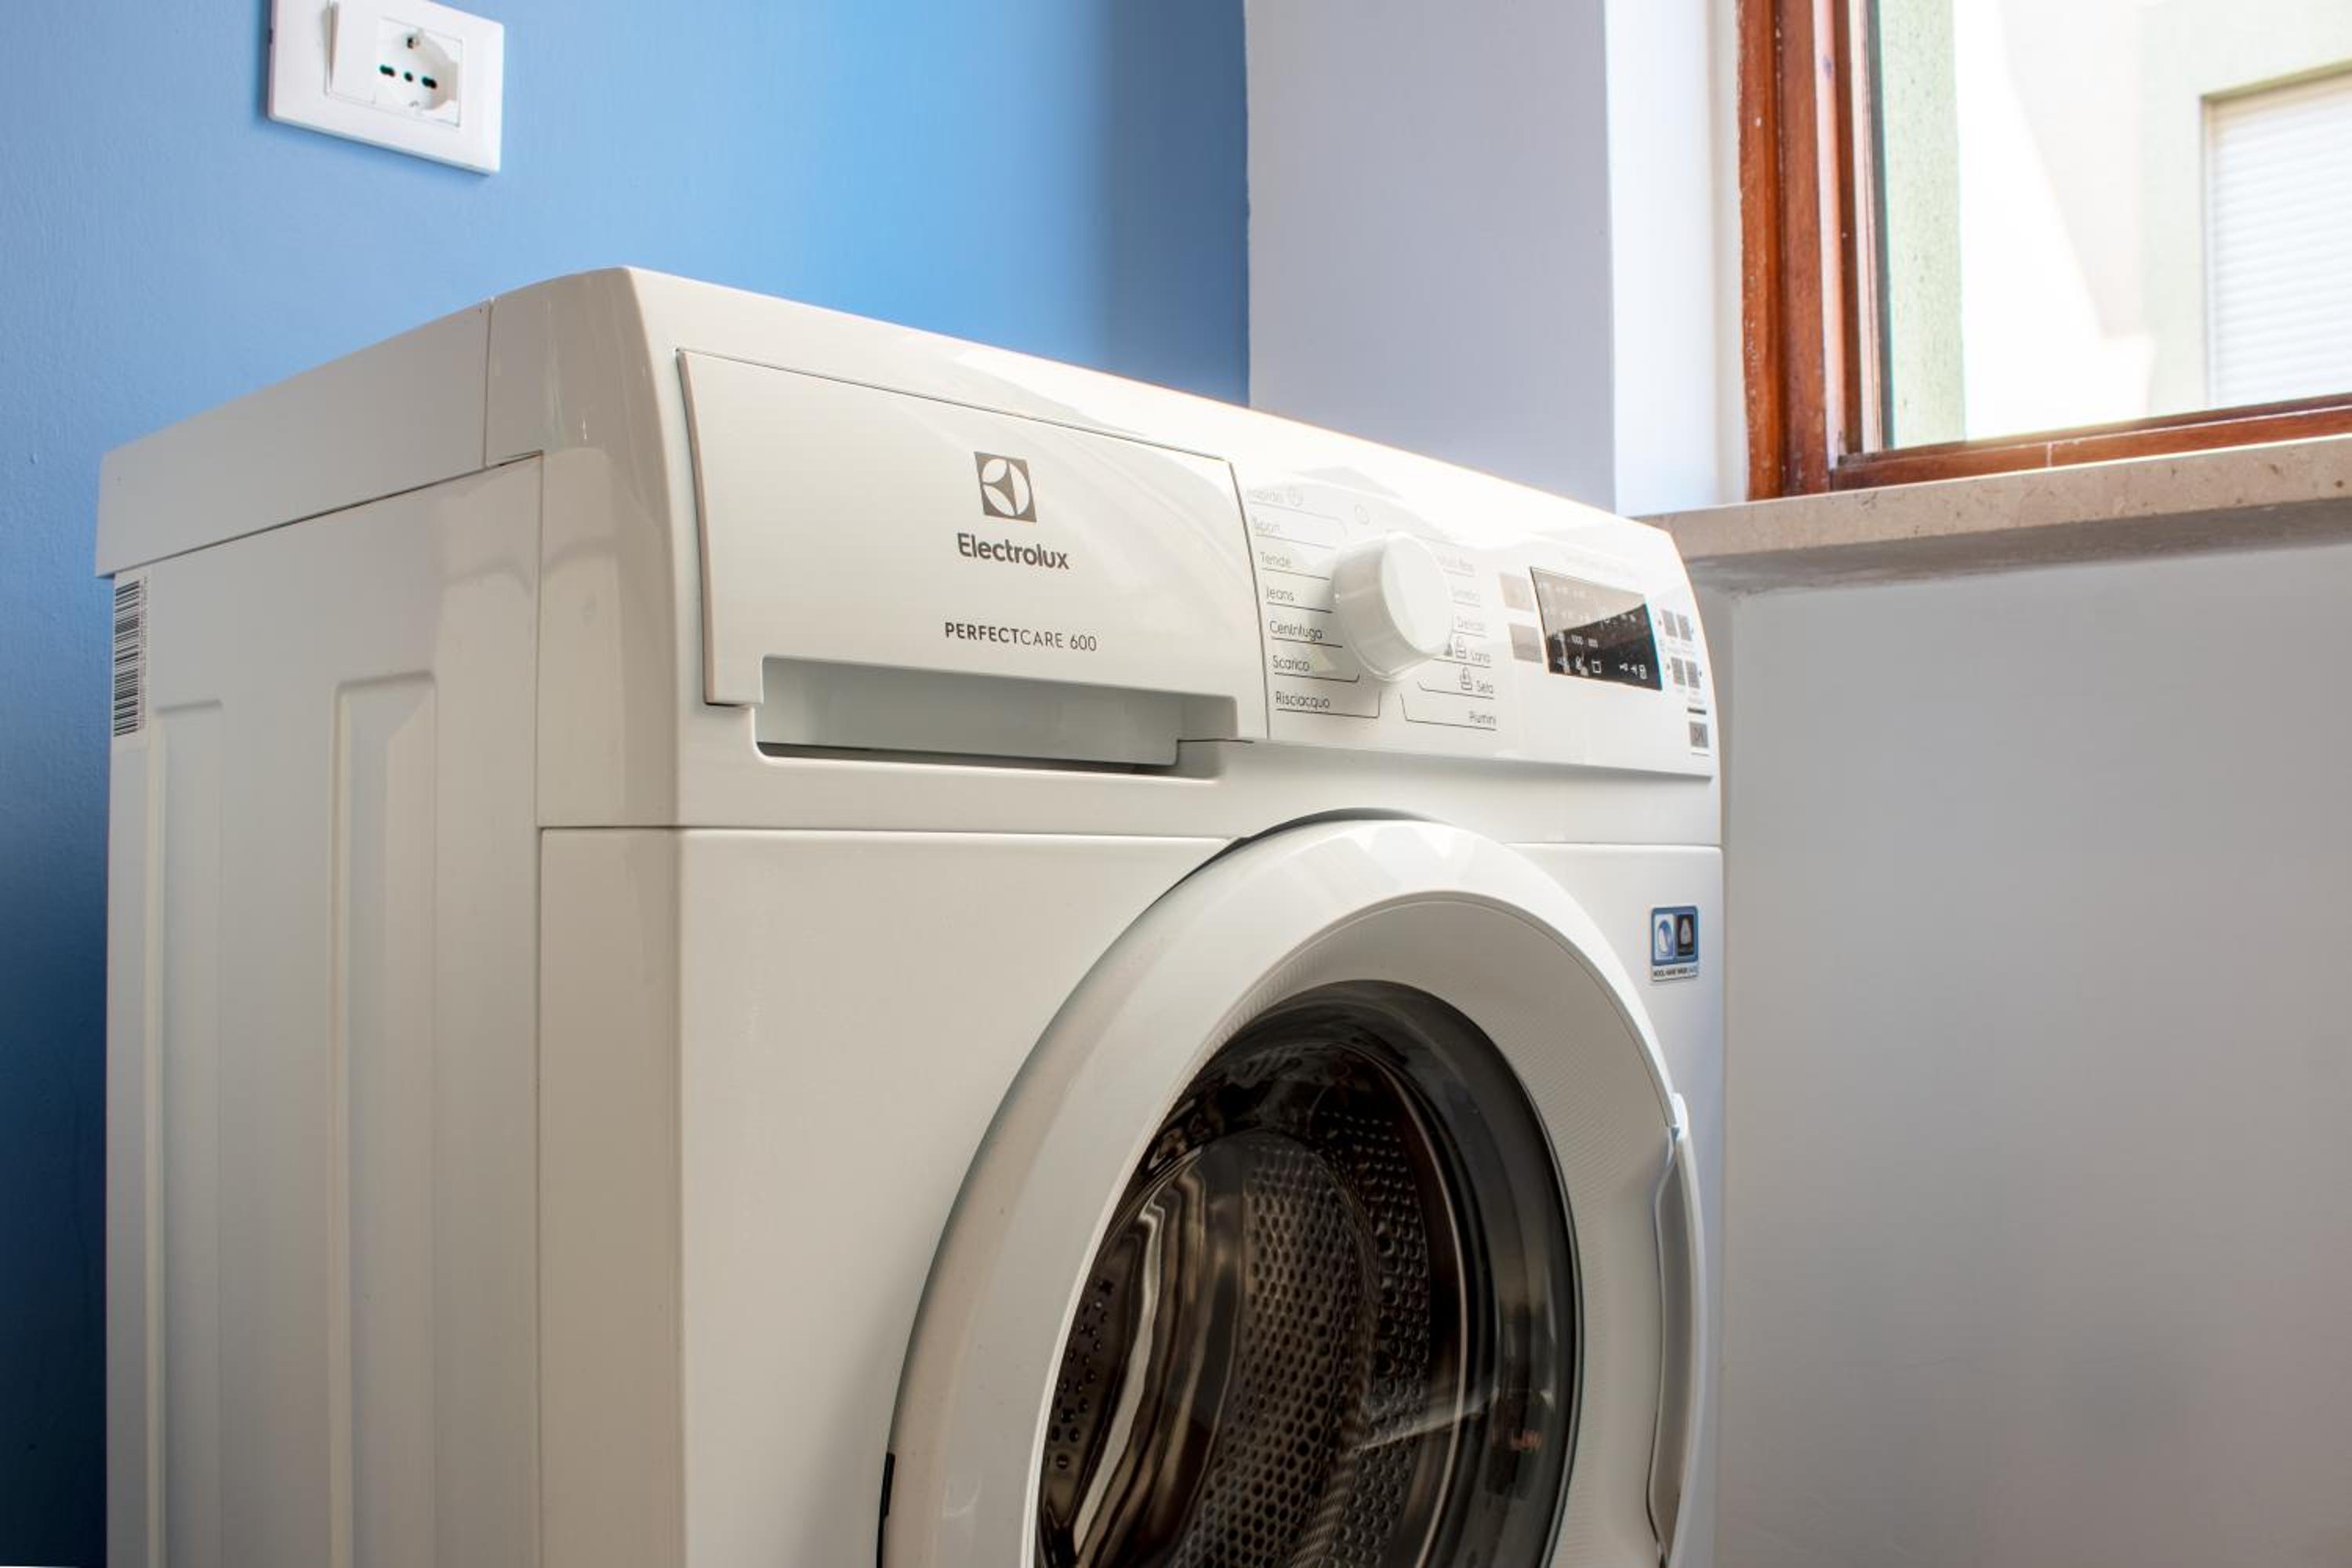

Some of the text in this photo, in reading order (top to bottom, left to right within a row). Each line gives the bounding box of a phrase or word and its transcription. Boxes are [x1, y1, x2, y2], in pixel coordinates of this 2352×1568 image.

[957, 532, 1069, 570] Electrolux
[945, 622, 1098, 652] PERFECTCARE 600
[1269, 620, 1323, 641] Centrifuga
[1272, 655, 1310, 672] Scarico
